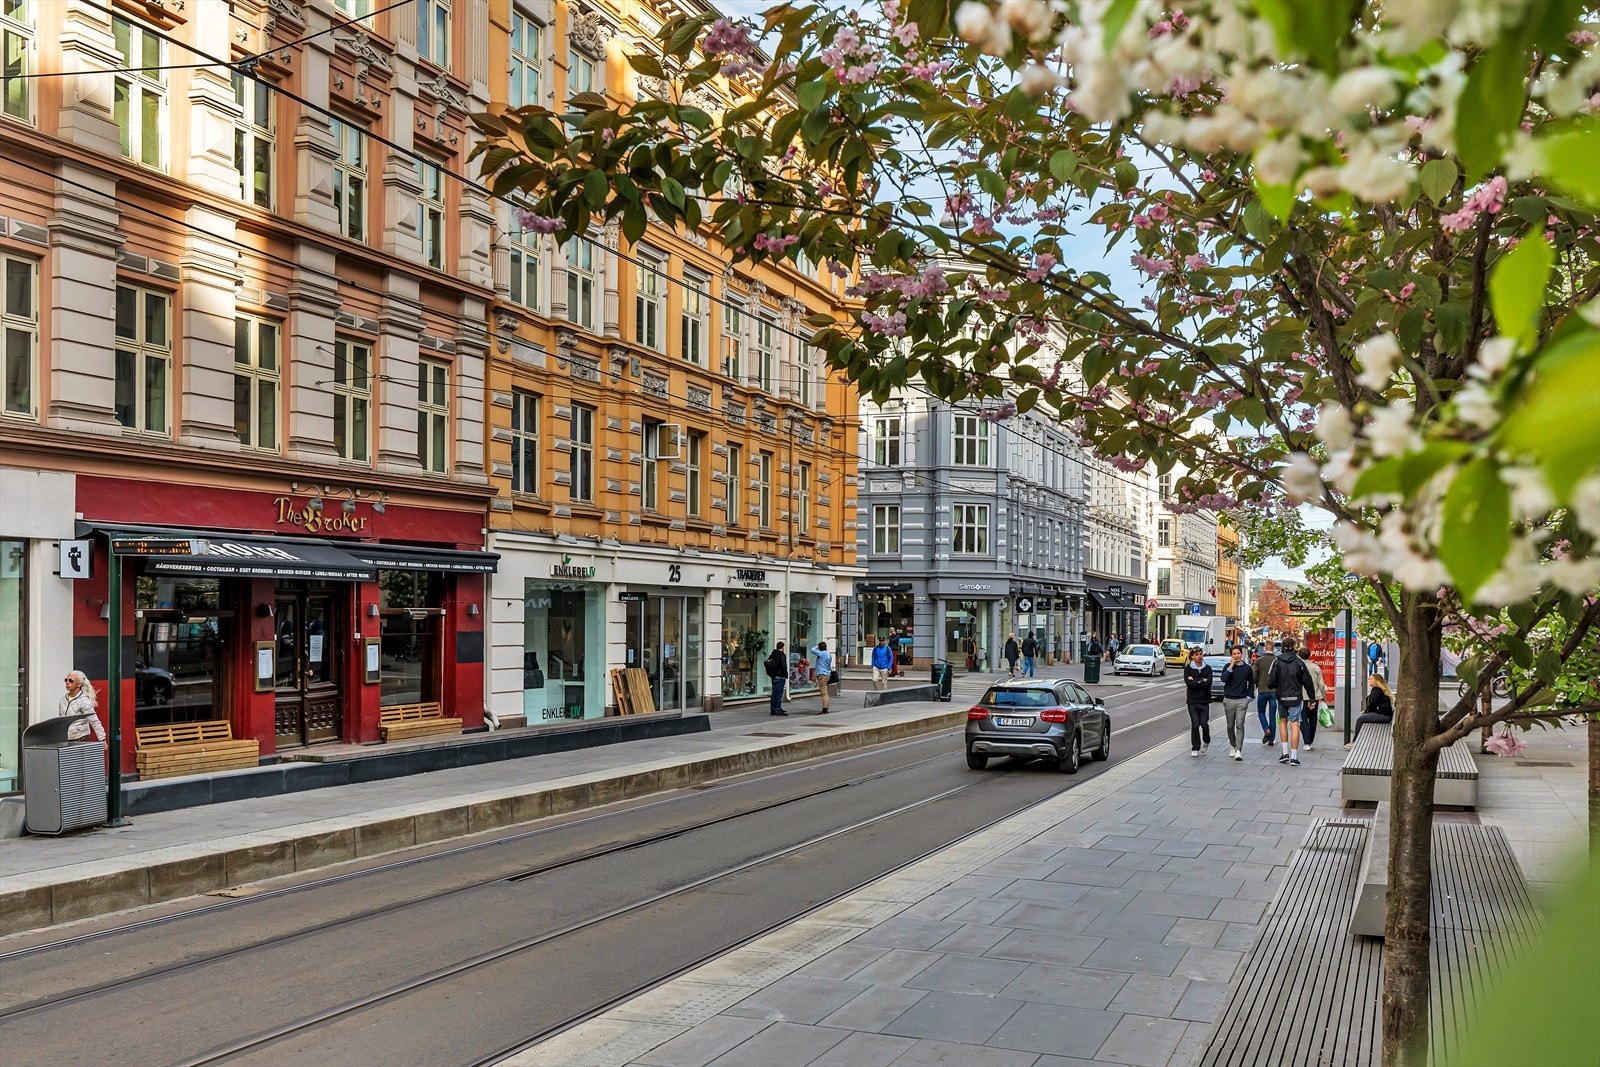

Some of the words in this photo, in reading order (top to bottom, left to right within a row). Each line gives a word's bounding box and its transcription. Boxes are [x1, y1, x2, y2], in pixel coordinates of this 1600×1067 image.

[274, 497, 302, 525] The
[553, 565, 596, 577] ENKLERELIV
[669, 564, 681, 583] 25
[959, 583, 991, 591] Samsonite
